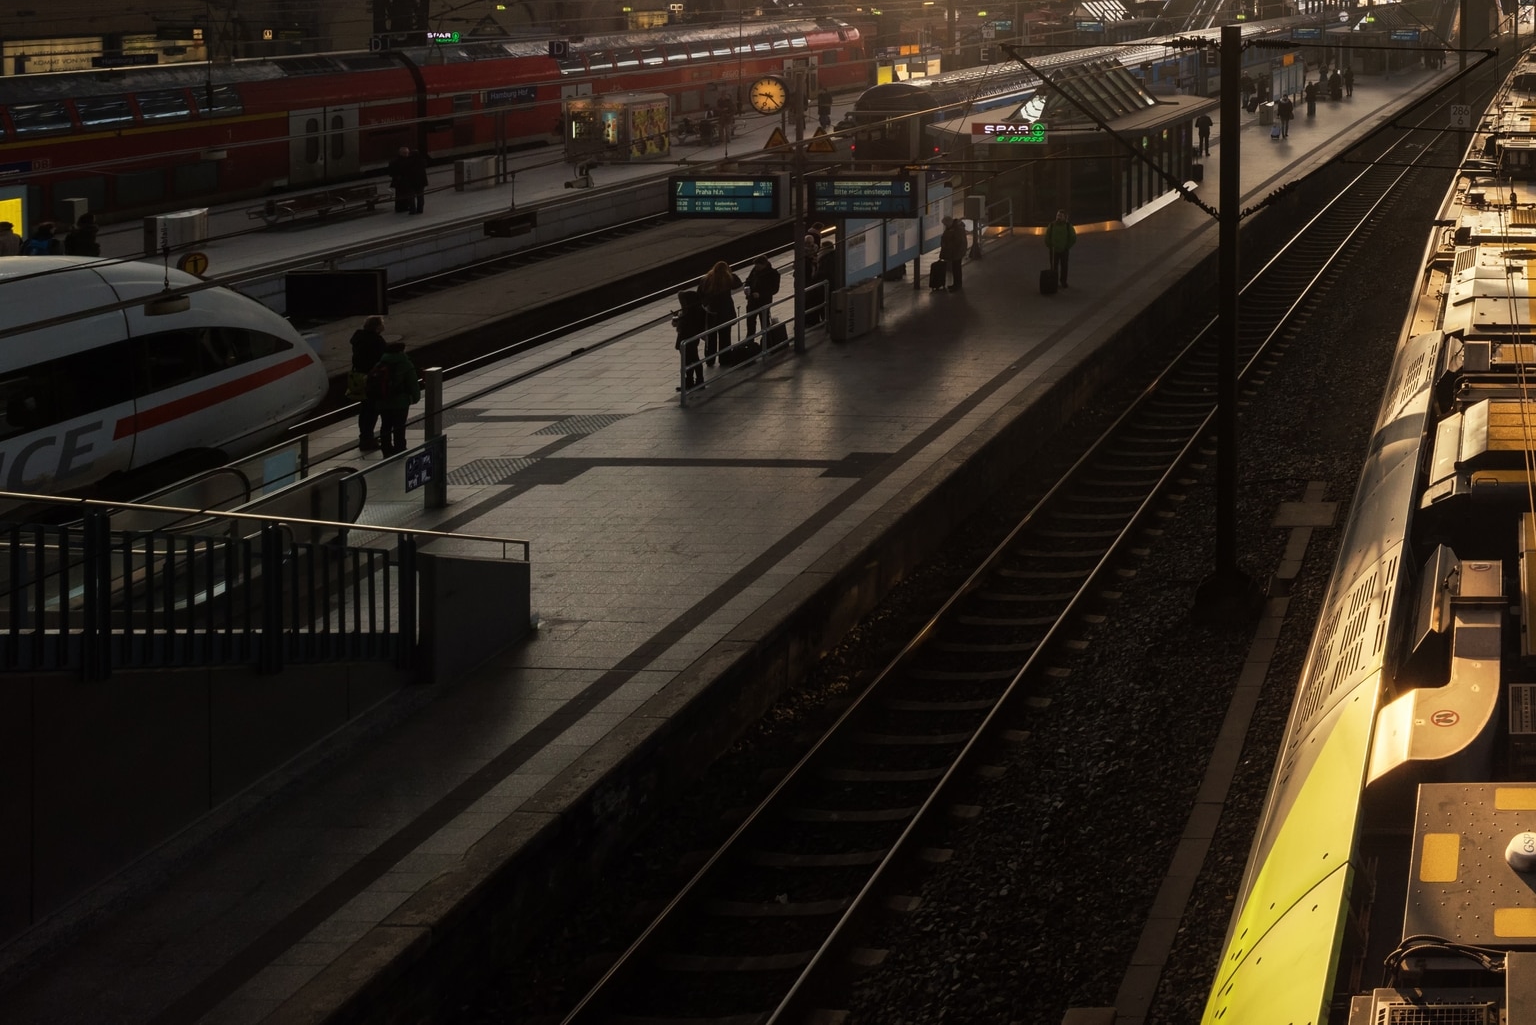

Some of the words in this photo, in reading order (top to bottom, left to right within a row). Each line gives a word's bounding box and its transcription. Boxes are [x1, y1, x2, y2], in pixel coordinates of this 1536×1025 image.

[554, 42, 564, 55] D
[980, 48, 990, 61] E
[1206, 50, 1215, 64] E
[490, 90, 517, 100] Hamburg
[517, 88, 528, 96] Hbf
[1452, 106, 1470, 116] 286
[1457, 116, 1464, 125] 6
[984, 125, 1029, 134] SPAR
[996, 135, 1044, 143] epress
[677, 182, 683, 192] 7
[904, 182, 911, 192] 8
[0, 420, 103, 491] CE
